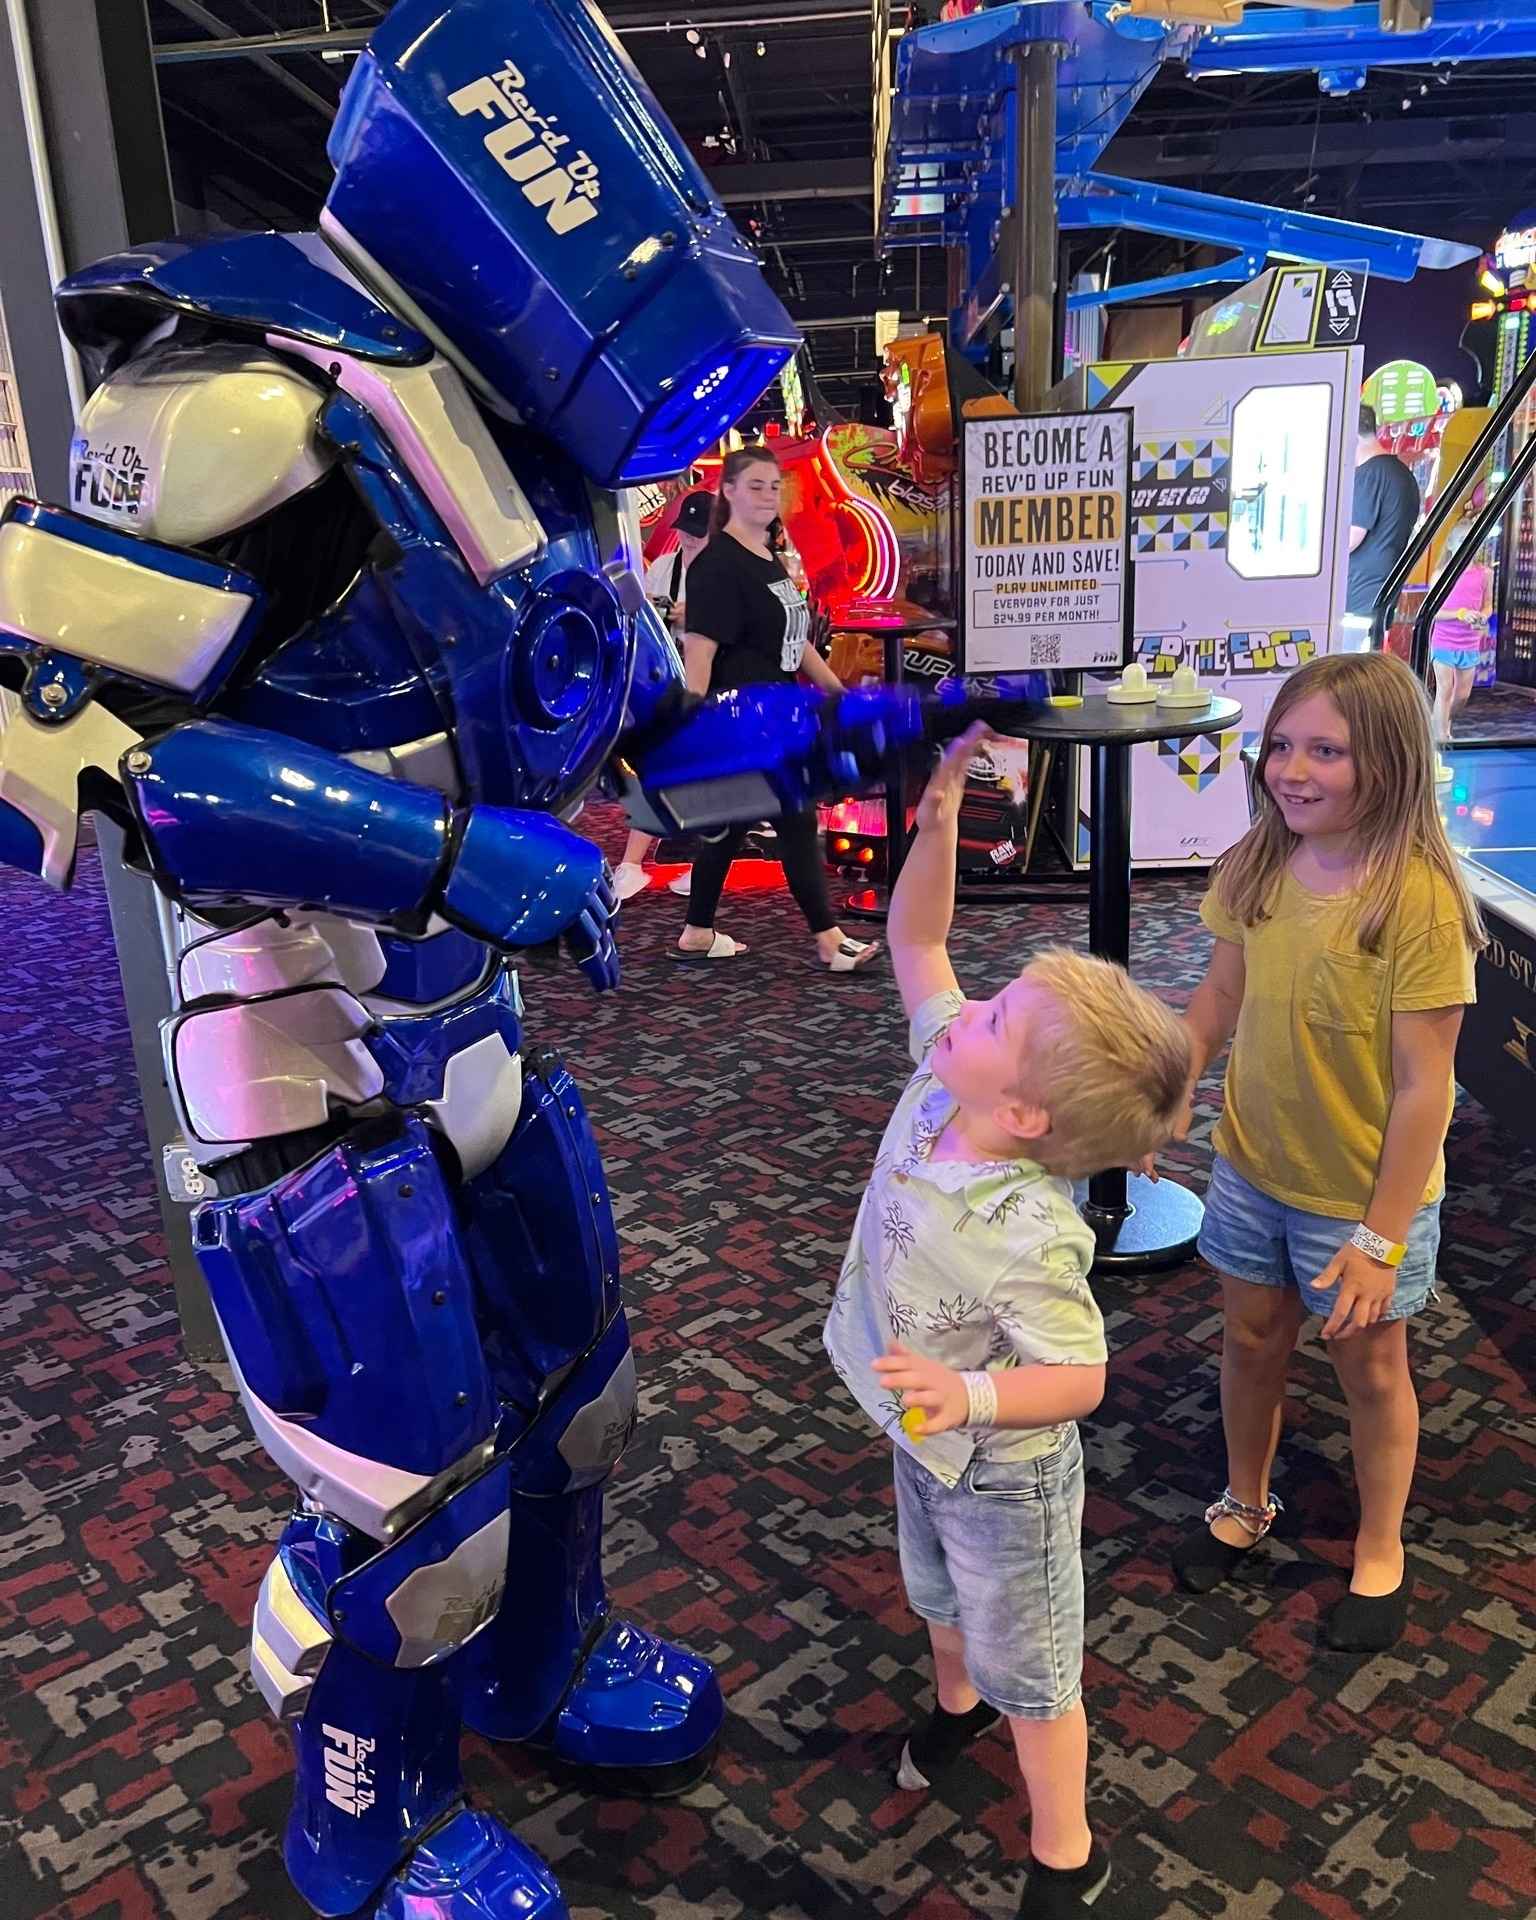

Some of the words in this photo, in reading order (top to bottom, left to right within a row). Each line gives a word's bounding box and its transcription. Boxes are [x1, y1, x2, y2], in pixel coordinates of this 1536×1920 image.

[491, 59, 570, 154] Rev'd
[567, 150, 600, 199] Up
[447, 76, 599, 235] FUN
[122, 445, 149, 473] Up
[984, 426, 1088, 468] BECOME
[1099, 425, 1114, 462] A
[982, 474, 1036, 494] REV'D
[1045, 471, 1068, 491] UP
[1077, 469, 1114, 489] FUN
[1156, 487, 1188, 506] SET
[1186, 486, 1211, 505] GO
[980, 494, 1115, 546] MEMBER
[975, 553, 1025, 578] TODAY
[1032, 551, 1065, 575] AND
[1073, 548, 1120, 573] SAVE!
[994, 598, 1047, 609] EVERYDAY
[1050, 596, 1070, 607] FOR
[1074, 594, 1100, 605] JUST
[996, 582, 1026, 594] PLAY
[1031, 578, 1097, 593] UNLIMITED
[993, 613, 1031, 625] $24.99
[1035, 611, 1055, 622] PER
[1058, 609, 1100, 621] MONTH!
[1185, 638, 1228, 676] THE
[1509, 950, 1536, 993] ST
[322, 1723, 356, 1815] FUN
